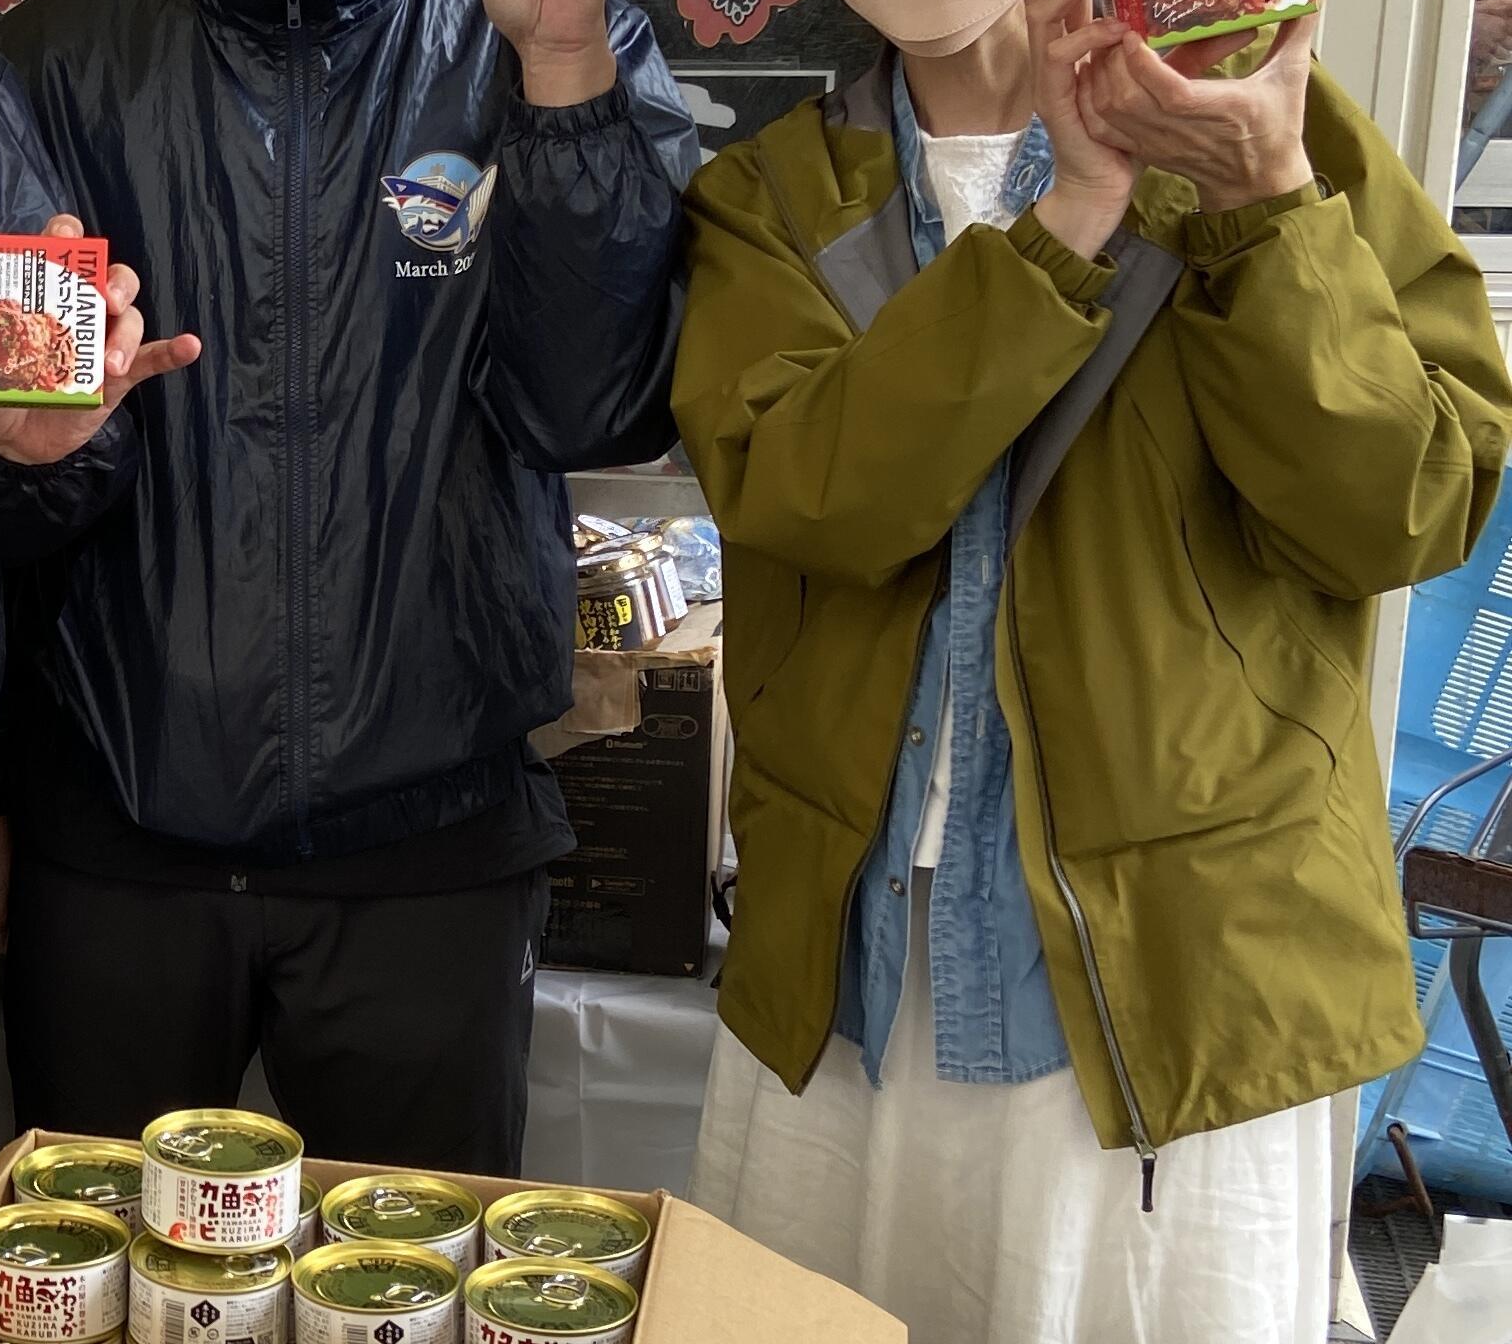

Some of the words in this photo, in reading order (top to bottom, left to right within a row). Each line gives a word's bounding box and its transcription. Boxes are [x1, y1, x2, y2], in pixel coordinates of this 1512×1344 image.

[395, 260, 448, 278] March
[454, 252, 476, 275] 20
[55, 249, 75, 383] イタリアンバーグ
[74, 250, 97, 385] ITALIANBURG
[199, 1180, 220, 1242] カルビ
[60, 1276, 77, 1338] やわらか
